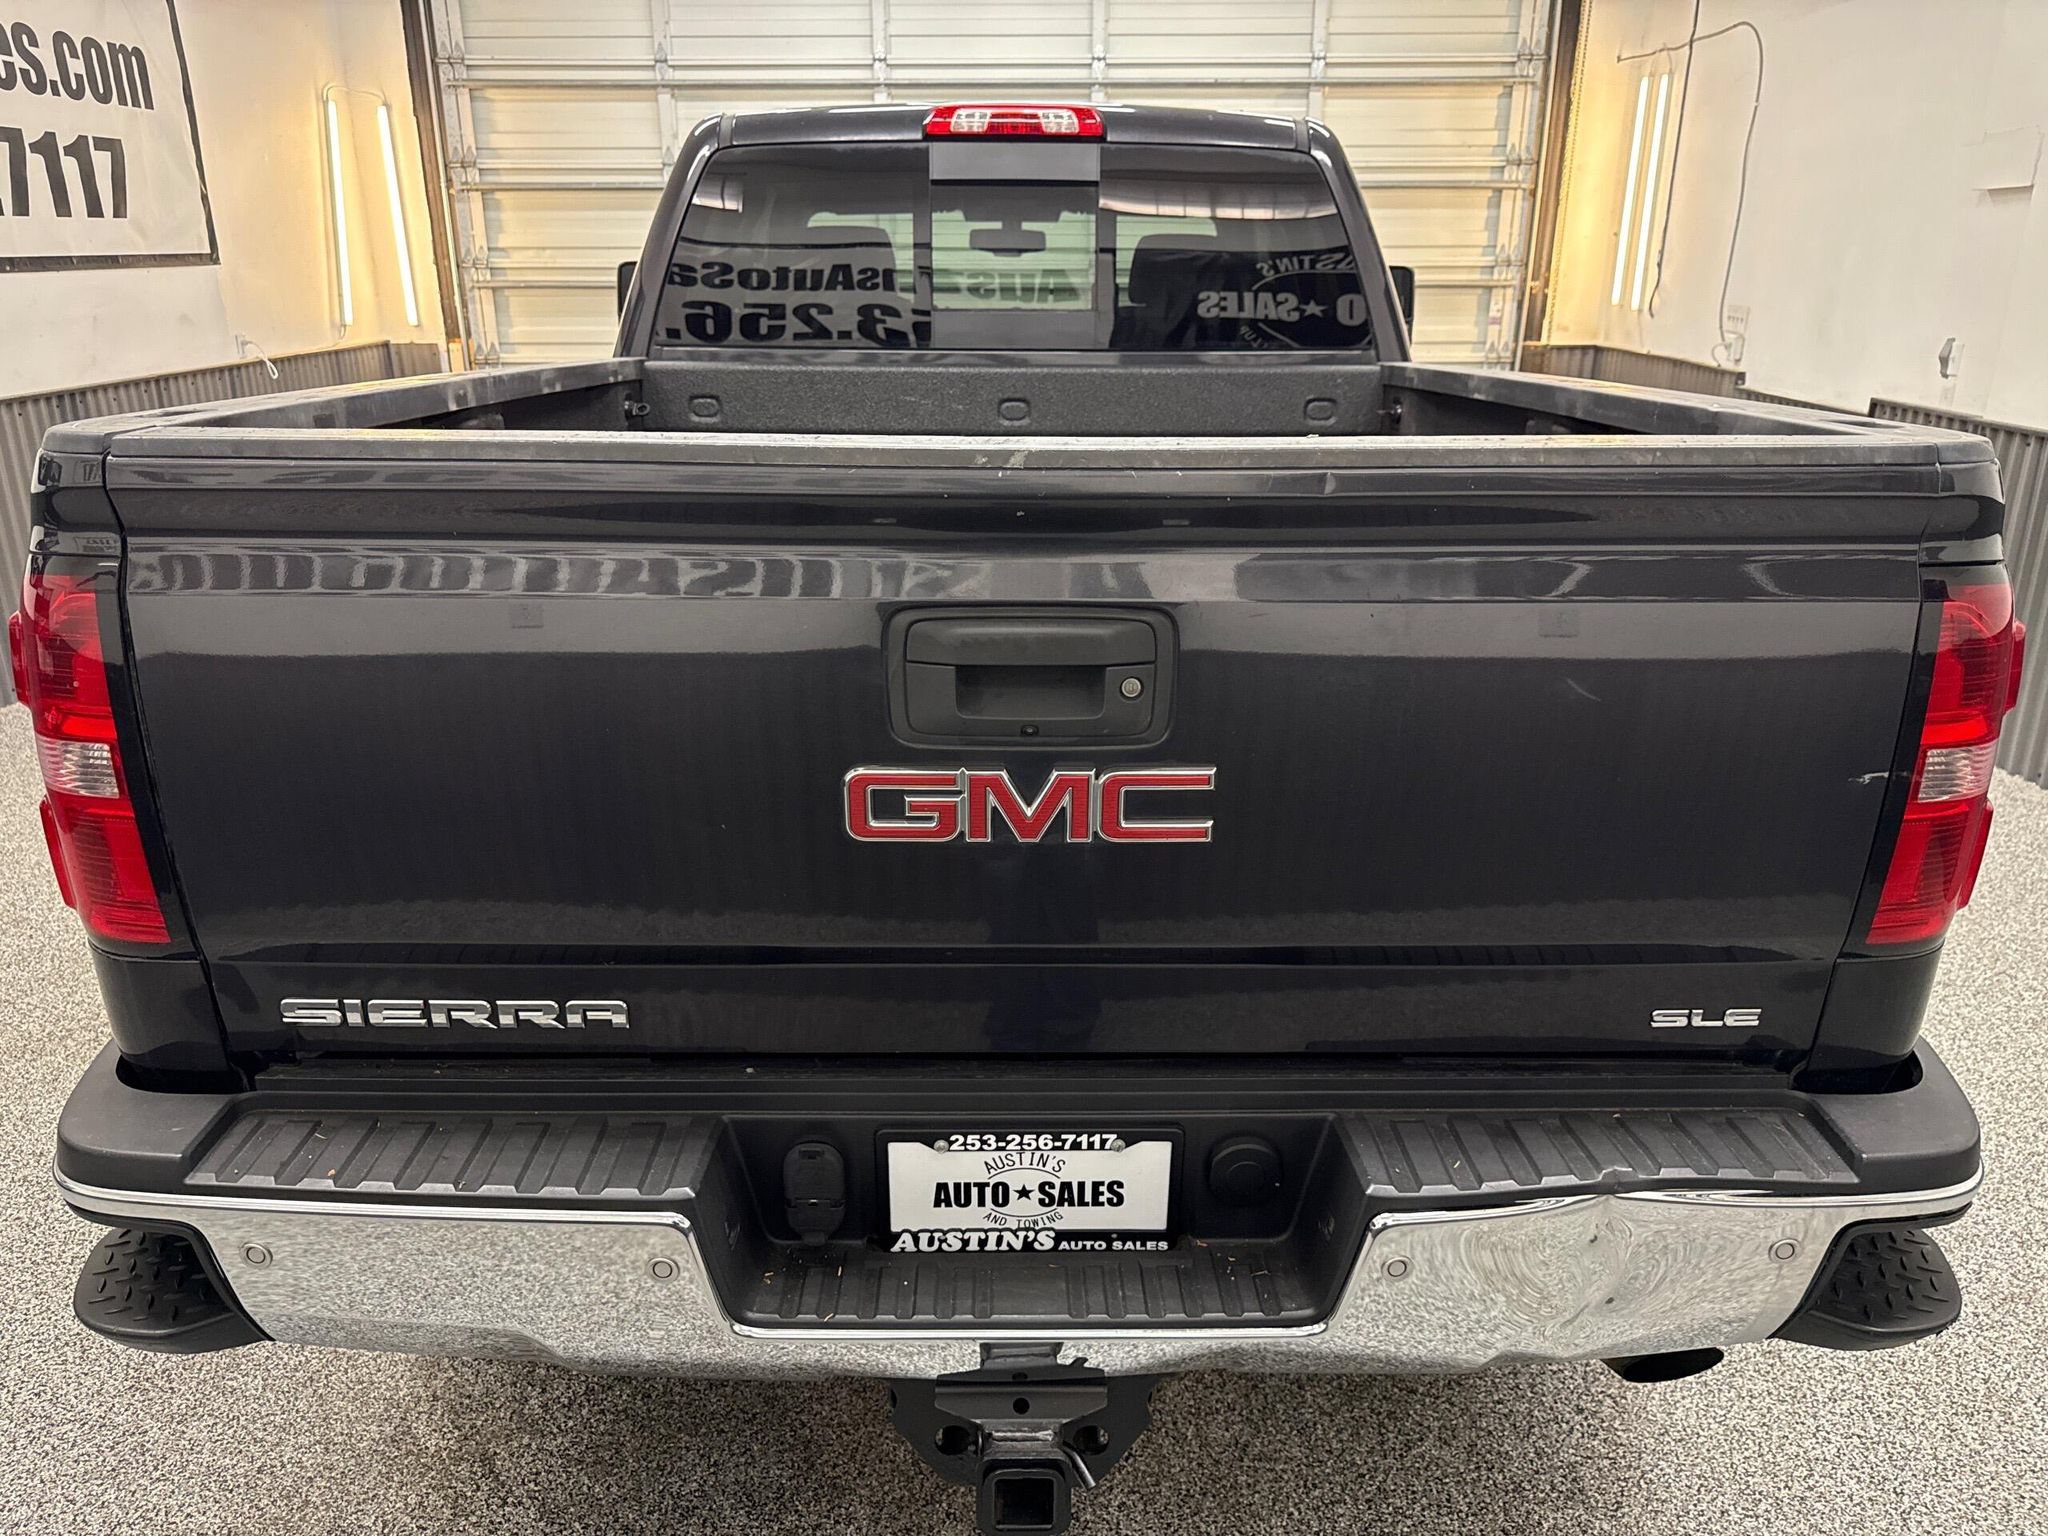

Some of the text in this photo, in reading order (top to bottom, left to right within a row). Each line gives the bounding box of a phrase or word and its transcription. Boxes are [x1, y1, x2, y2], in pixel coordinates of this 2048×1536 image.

[0, 126, 127, 219] 7117
[843, 767, 1216, 843] GMC
[280, 998, 629, 1029] SIERRA
[1651, 1008, 1762, 1027] SLE
[949, 1134, 1117, 1150] 253-256-7117
[984, 1152, 1066, 1174] AUSTIN'S
[933, 1180, 1125, 1208] AUTO SALES
[983, 1211, 1064, 1229] AND TOWING
[890, 1230, 1168, 1252] AUSTIN'S AUTO SALES
